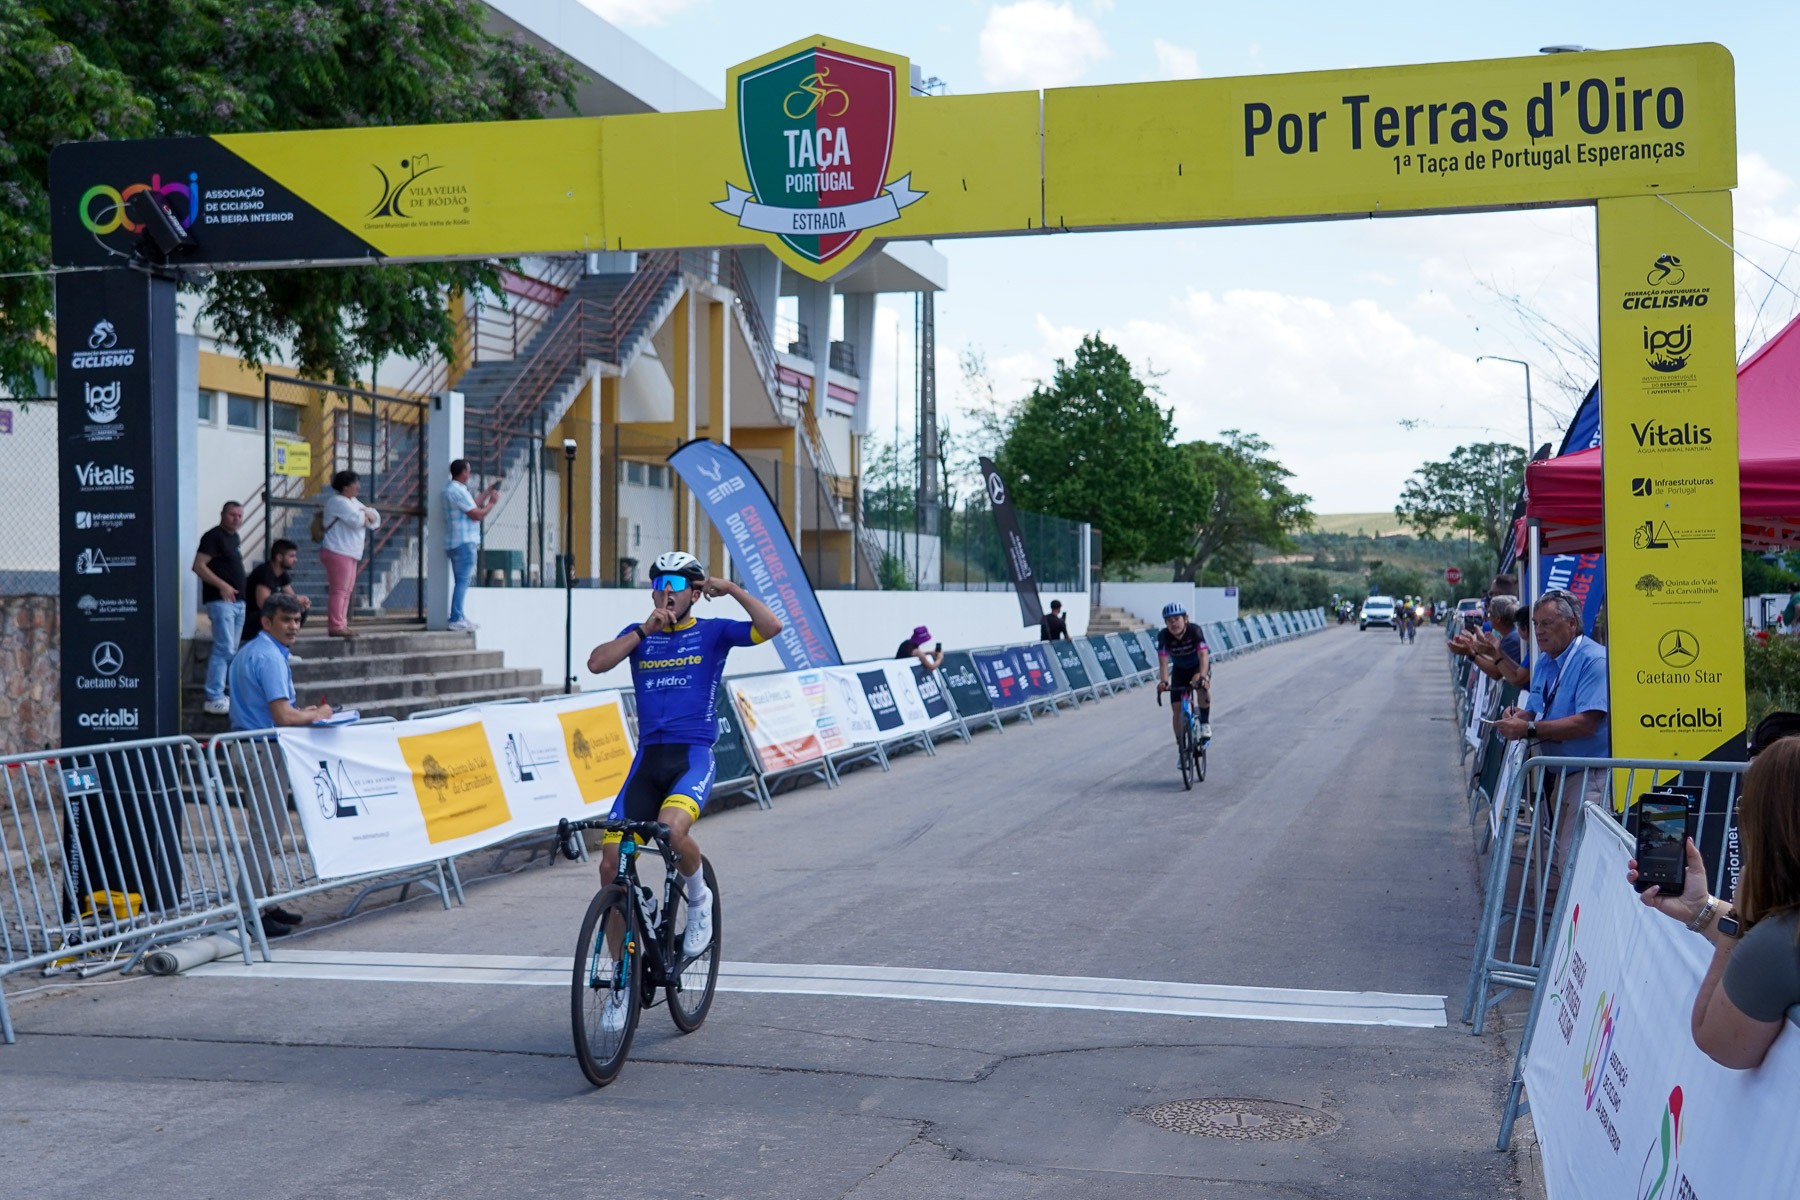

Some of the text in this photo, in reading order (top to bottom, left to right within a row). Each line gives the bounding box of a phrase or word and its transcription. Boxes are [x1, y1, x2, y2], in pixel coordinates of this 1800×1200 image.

[1244, 76, 1685, 157] Por Terras d'Oiro
[783, 126, 852, 172] TAÇA
[1393, 141, 1686, 177] 1ª Taça de Portugal Esperanças
[785, 171, 855, 194] PORTUGAL
[205, 187, 265, 200] ASSOCIAÇÃO
[410, 186, 467, 196] VILA VELHA
[205, 201, 264, 212] DE CICLISMO
[410, 196, 467, 207] DE RÓDÃO
[205, 212, 294, 224] DA BEIRA INTERIOR
[792, 212, 847, 230] ESTRADA
[1622, 294, 1708, 310] CICLISMO
[71, 354, 134, 369] CICLISMO
[1630, 418, 1712, 446] Vitalis
[75, 461, 135, 486] Vitalis
[1654, 478, 1714, 486] Infraestruturas
[1668, 487, 1697, 496] Portugal
[1665, 579, 1690, 587] Quinta
[1702, 578, 1718, 586] Vale
[1676, 587, 1719, 595] Carvalhinha
[639, 654, 702, 669] novocorte
[76, 675, 140, 690] Caetano Star
[656, 677, 688, 688] Hidro
[1636, 670, 1722, 684] Caetano Star
[78, 708, 139, 727] acrialbi
[1640, 708, 1722, 728] acrialbi
